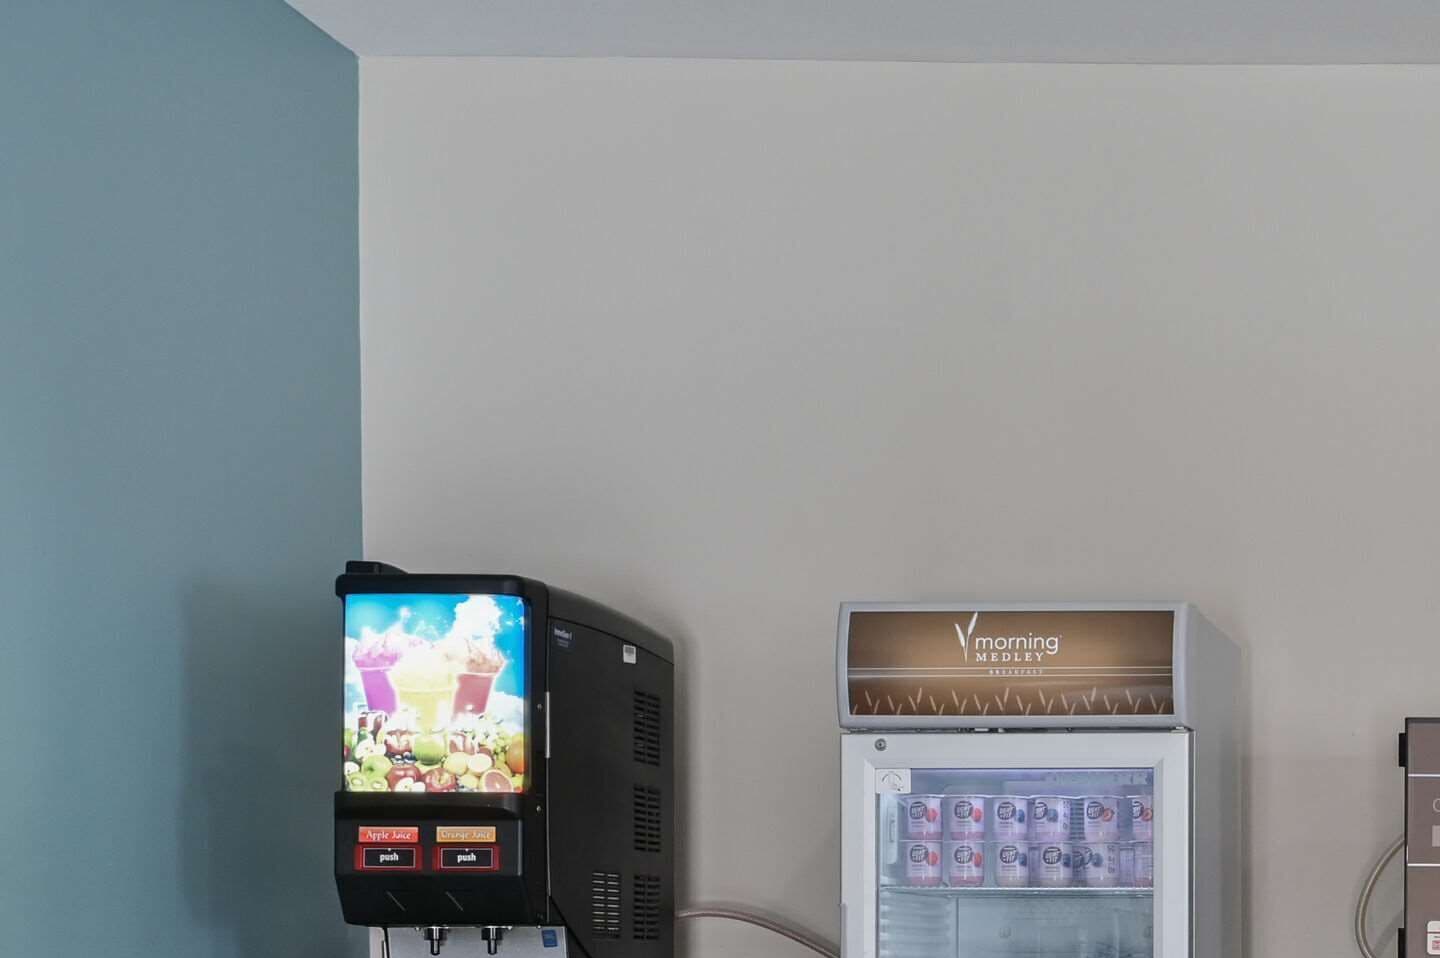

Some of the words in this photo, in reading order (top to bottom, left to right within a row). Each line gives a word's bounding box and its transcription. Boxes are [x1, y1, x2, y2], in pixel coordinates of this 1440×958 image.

[975, 632, 1060, 655] morning
[975, 652, 1044, 662] MEDLEY
[366, 829, 390, 841] Apple
[391, 829, 411, 840] Juice
[441, 829, 470, 841] Orange
[471, 829, 492, 840] Juice
[379, 852, 399, 863] push
[457, 852, 477, 863] push
